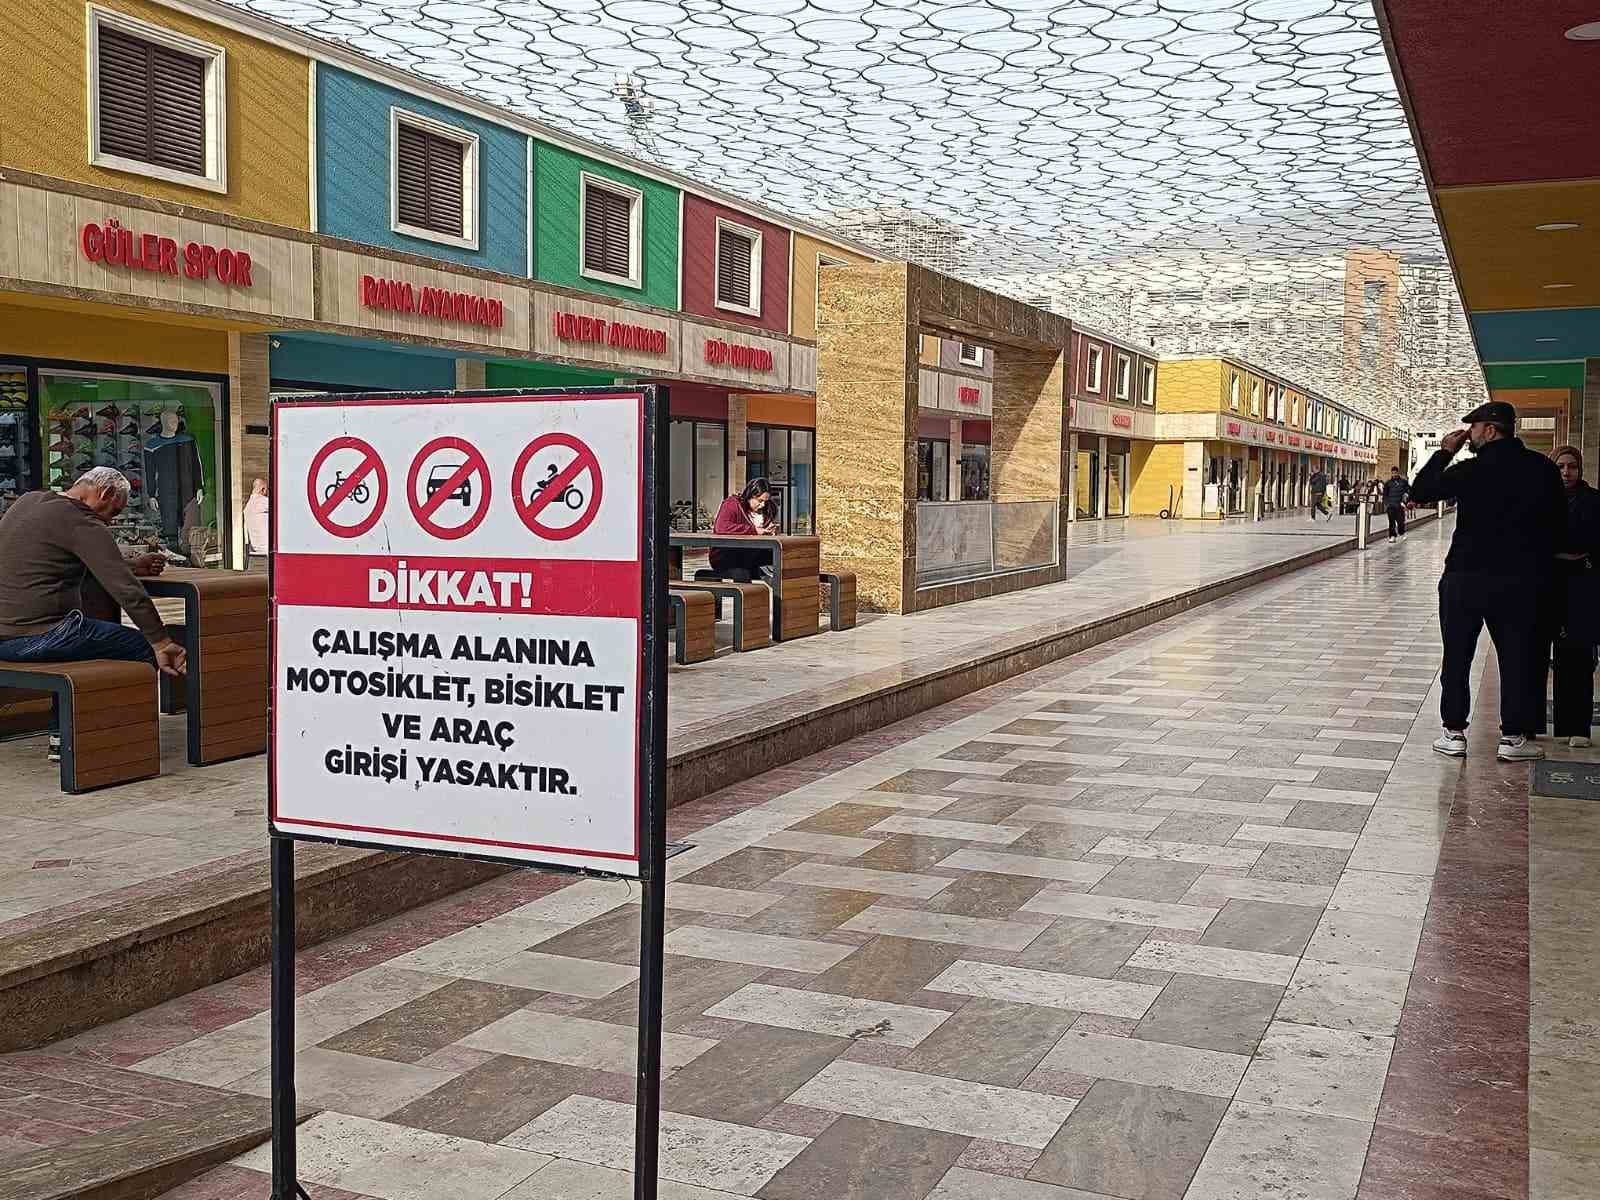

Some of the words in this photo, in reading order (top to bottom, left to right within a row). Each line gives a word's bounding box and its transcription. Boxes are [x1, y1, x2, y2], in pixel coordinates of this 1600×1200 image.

[81, 218, 179, 276] GÜLER
[183, 241, 252, 287] SPOR
[361, 273, 416, 313] RANA
[418, 286, 504, 328] AYAKKABI
[554, 311, 606, 344] LEVENT
[367, 560, 533, 608] DİKKAT!
[312, 628, 443, 662] ÇALIŞMA
[450, 635, 596, 668] ALANINA
[286, 666, 476, 709] MOTOSİKLET,
[484, 673, 625, 713] BİSİKLET
[381, 712, 421, 741] VE
[429, 716, 516, 752] ARAÇ
[324, 744, 408, 784] GİRİŞİ
[415, 756, 578, 796] YASAKTIR.
